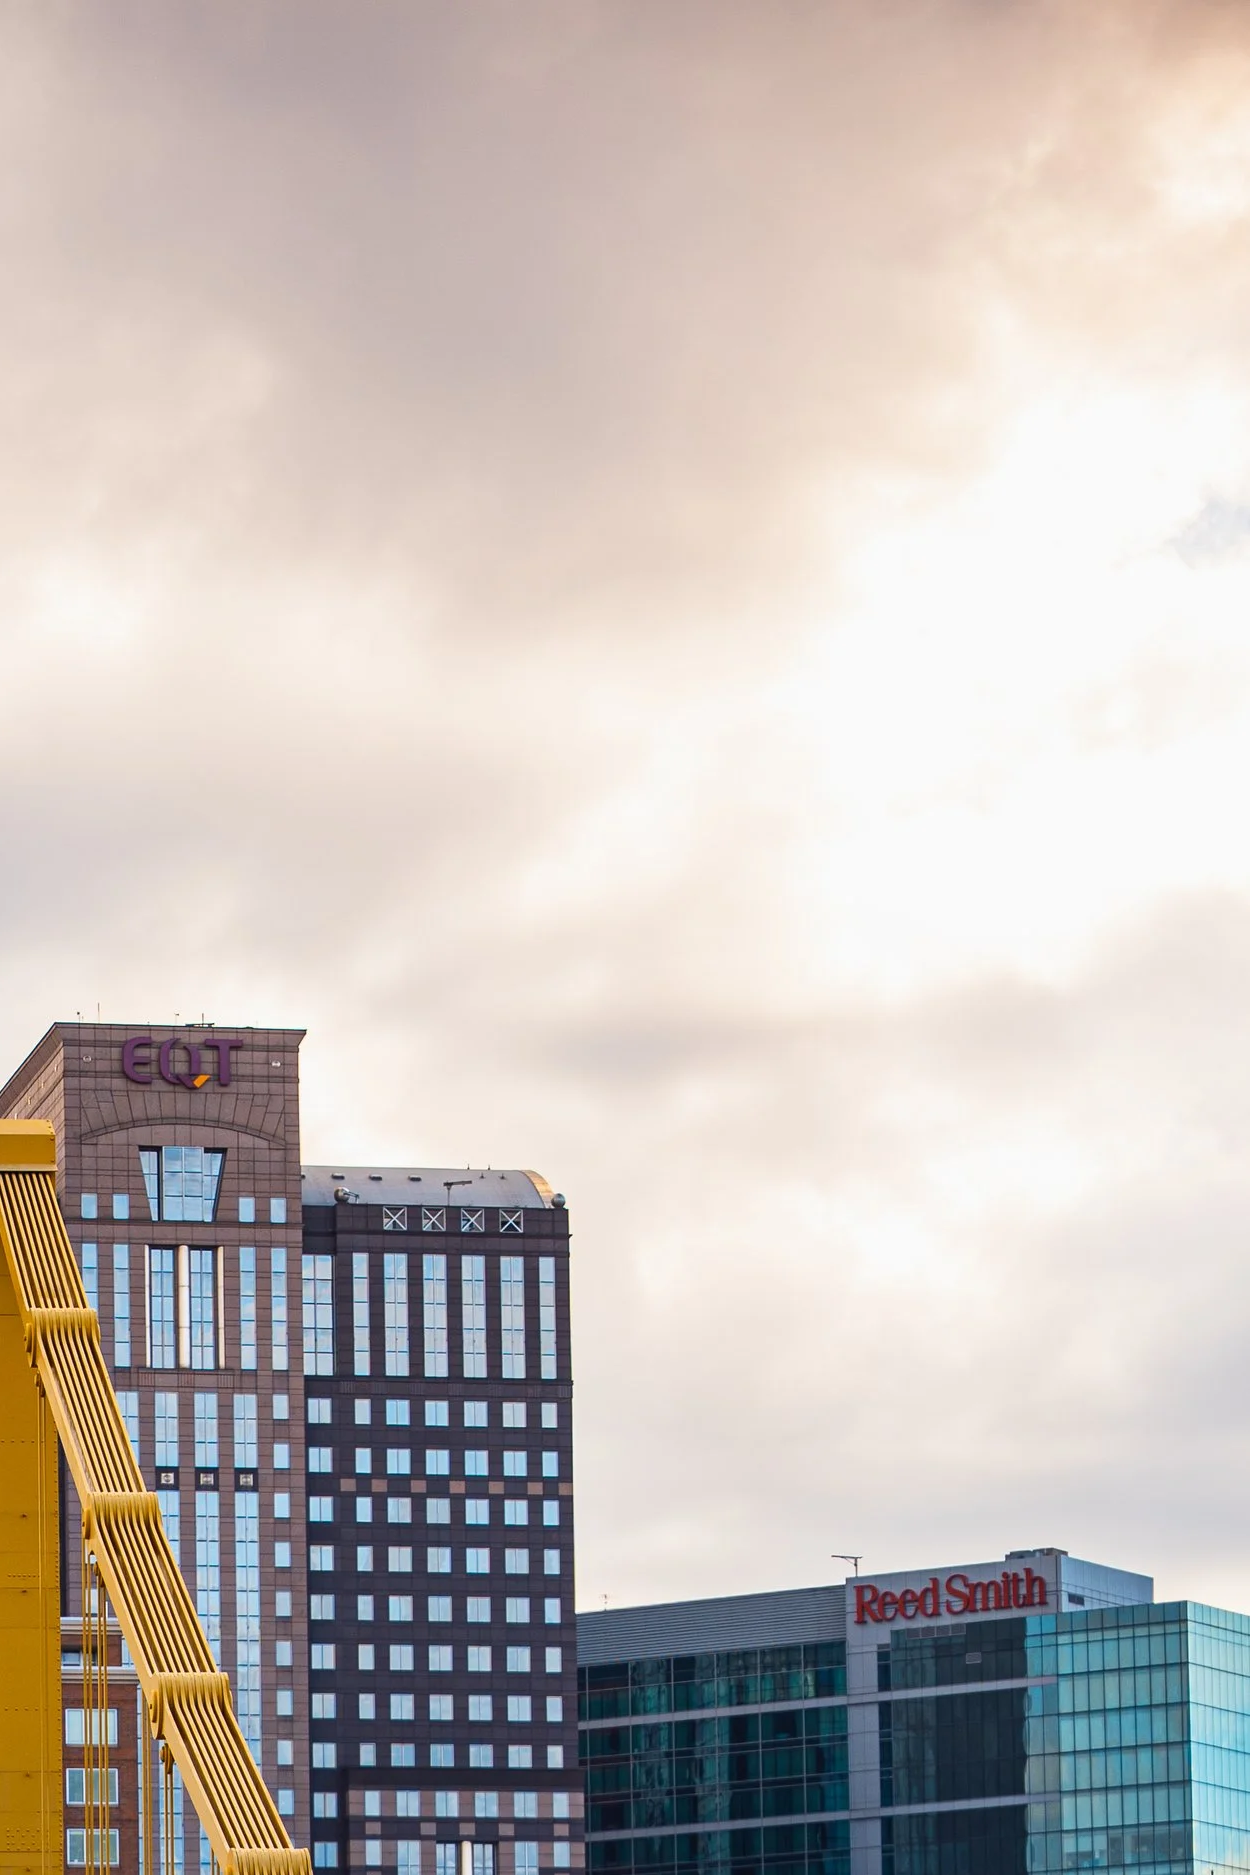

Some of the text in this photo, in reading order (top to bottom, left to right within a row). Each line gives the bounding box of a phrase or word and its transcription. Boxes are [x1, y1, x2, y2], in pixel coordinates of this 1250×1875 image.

[122, 1036, 243, 1089] EQT
[853, 1567, 1048, 1624] Reed Smith
